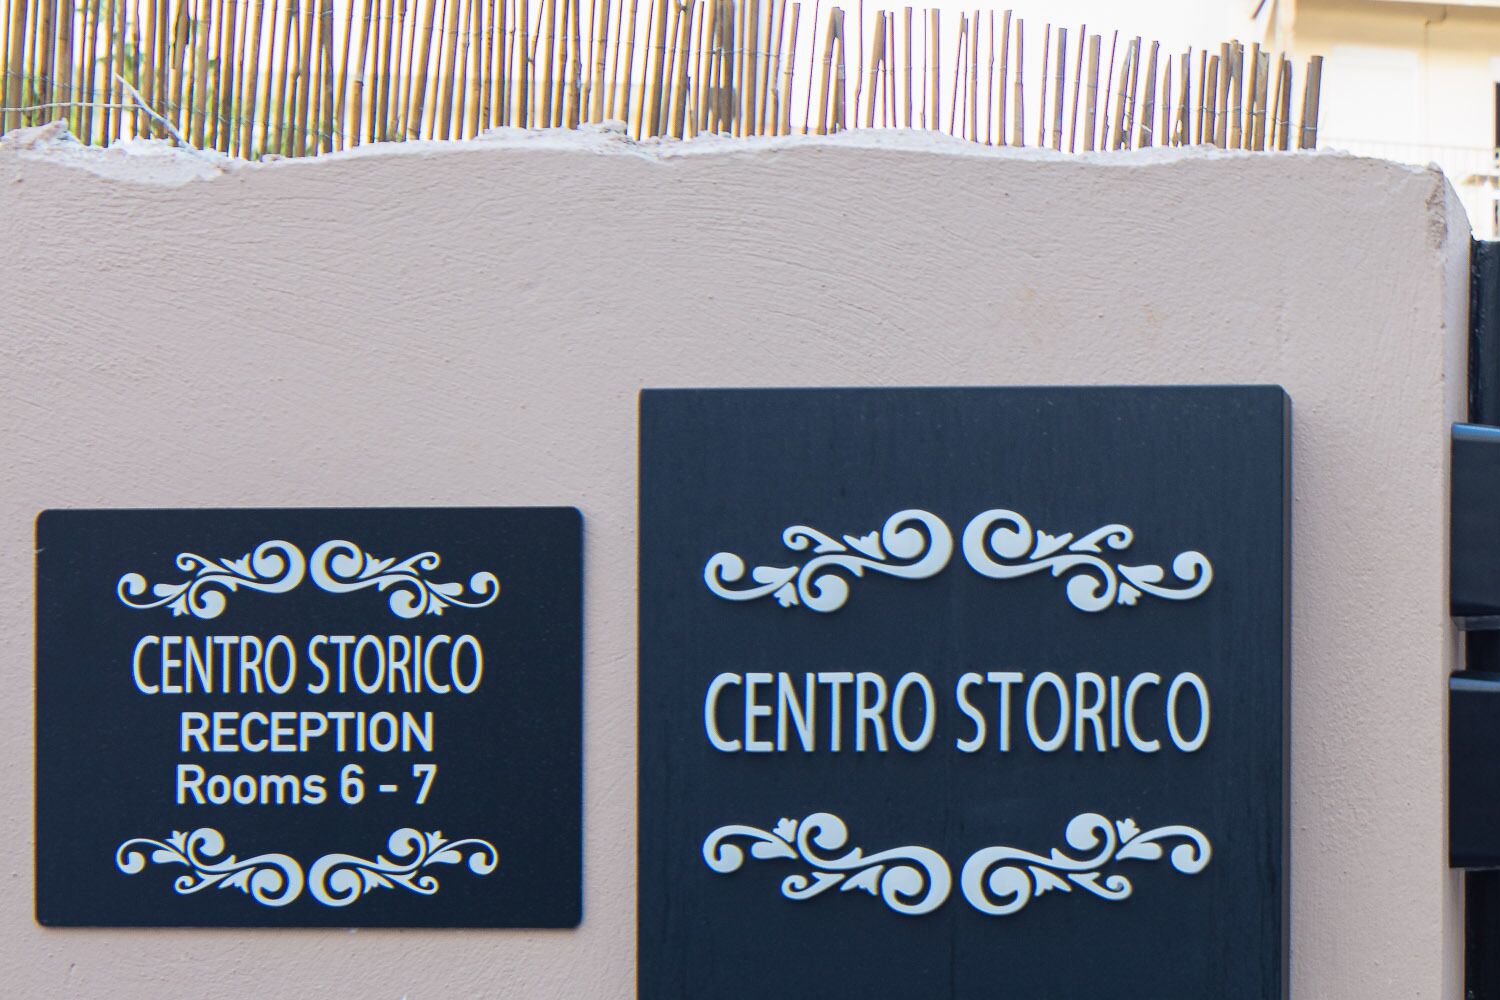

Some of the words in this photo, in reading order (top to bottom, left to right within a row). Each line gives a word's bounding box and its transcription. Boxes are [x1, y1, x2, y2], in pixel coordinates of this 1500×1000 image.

[133, 634, 296, 694] CENTRO
[307, 633, 483, 694] STORICO
[180, 711, 433, 752] RECEPTION
[705, 670, 935, 754] CENTRO
[956, 670, 1211, 754] STORICO
[176, 763, 326, 804] Rooms
[340, 763, 363, 804] 6
[379, 782, 397, 791] -
[412, 763, 437, 804] 7
